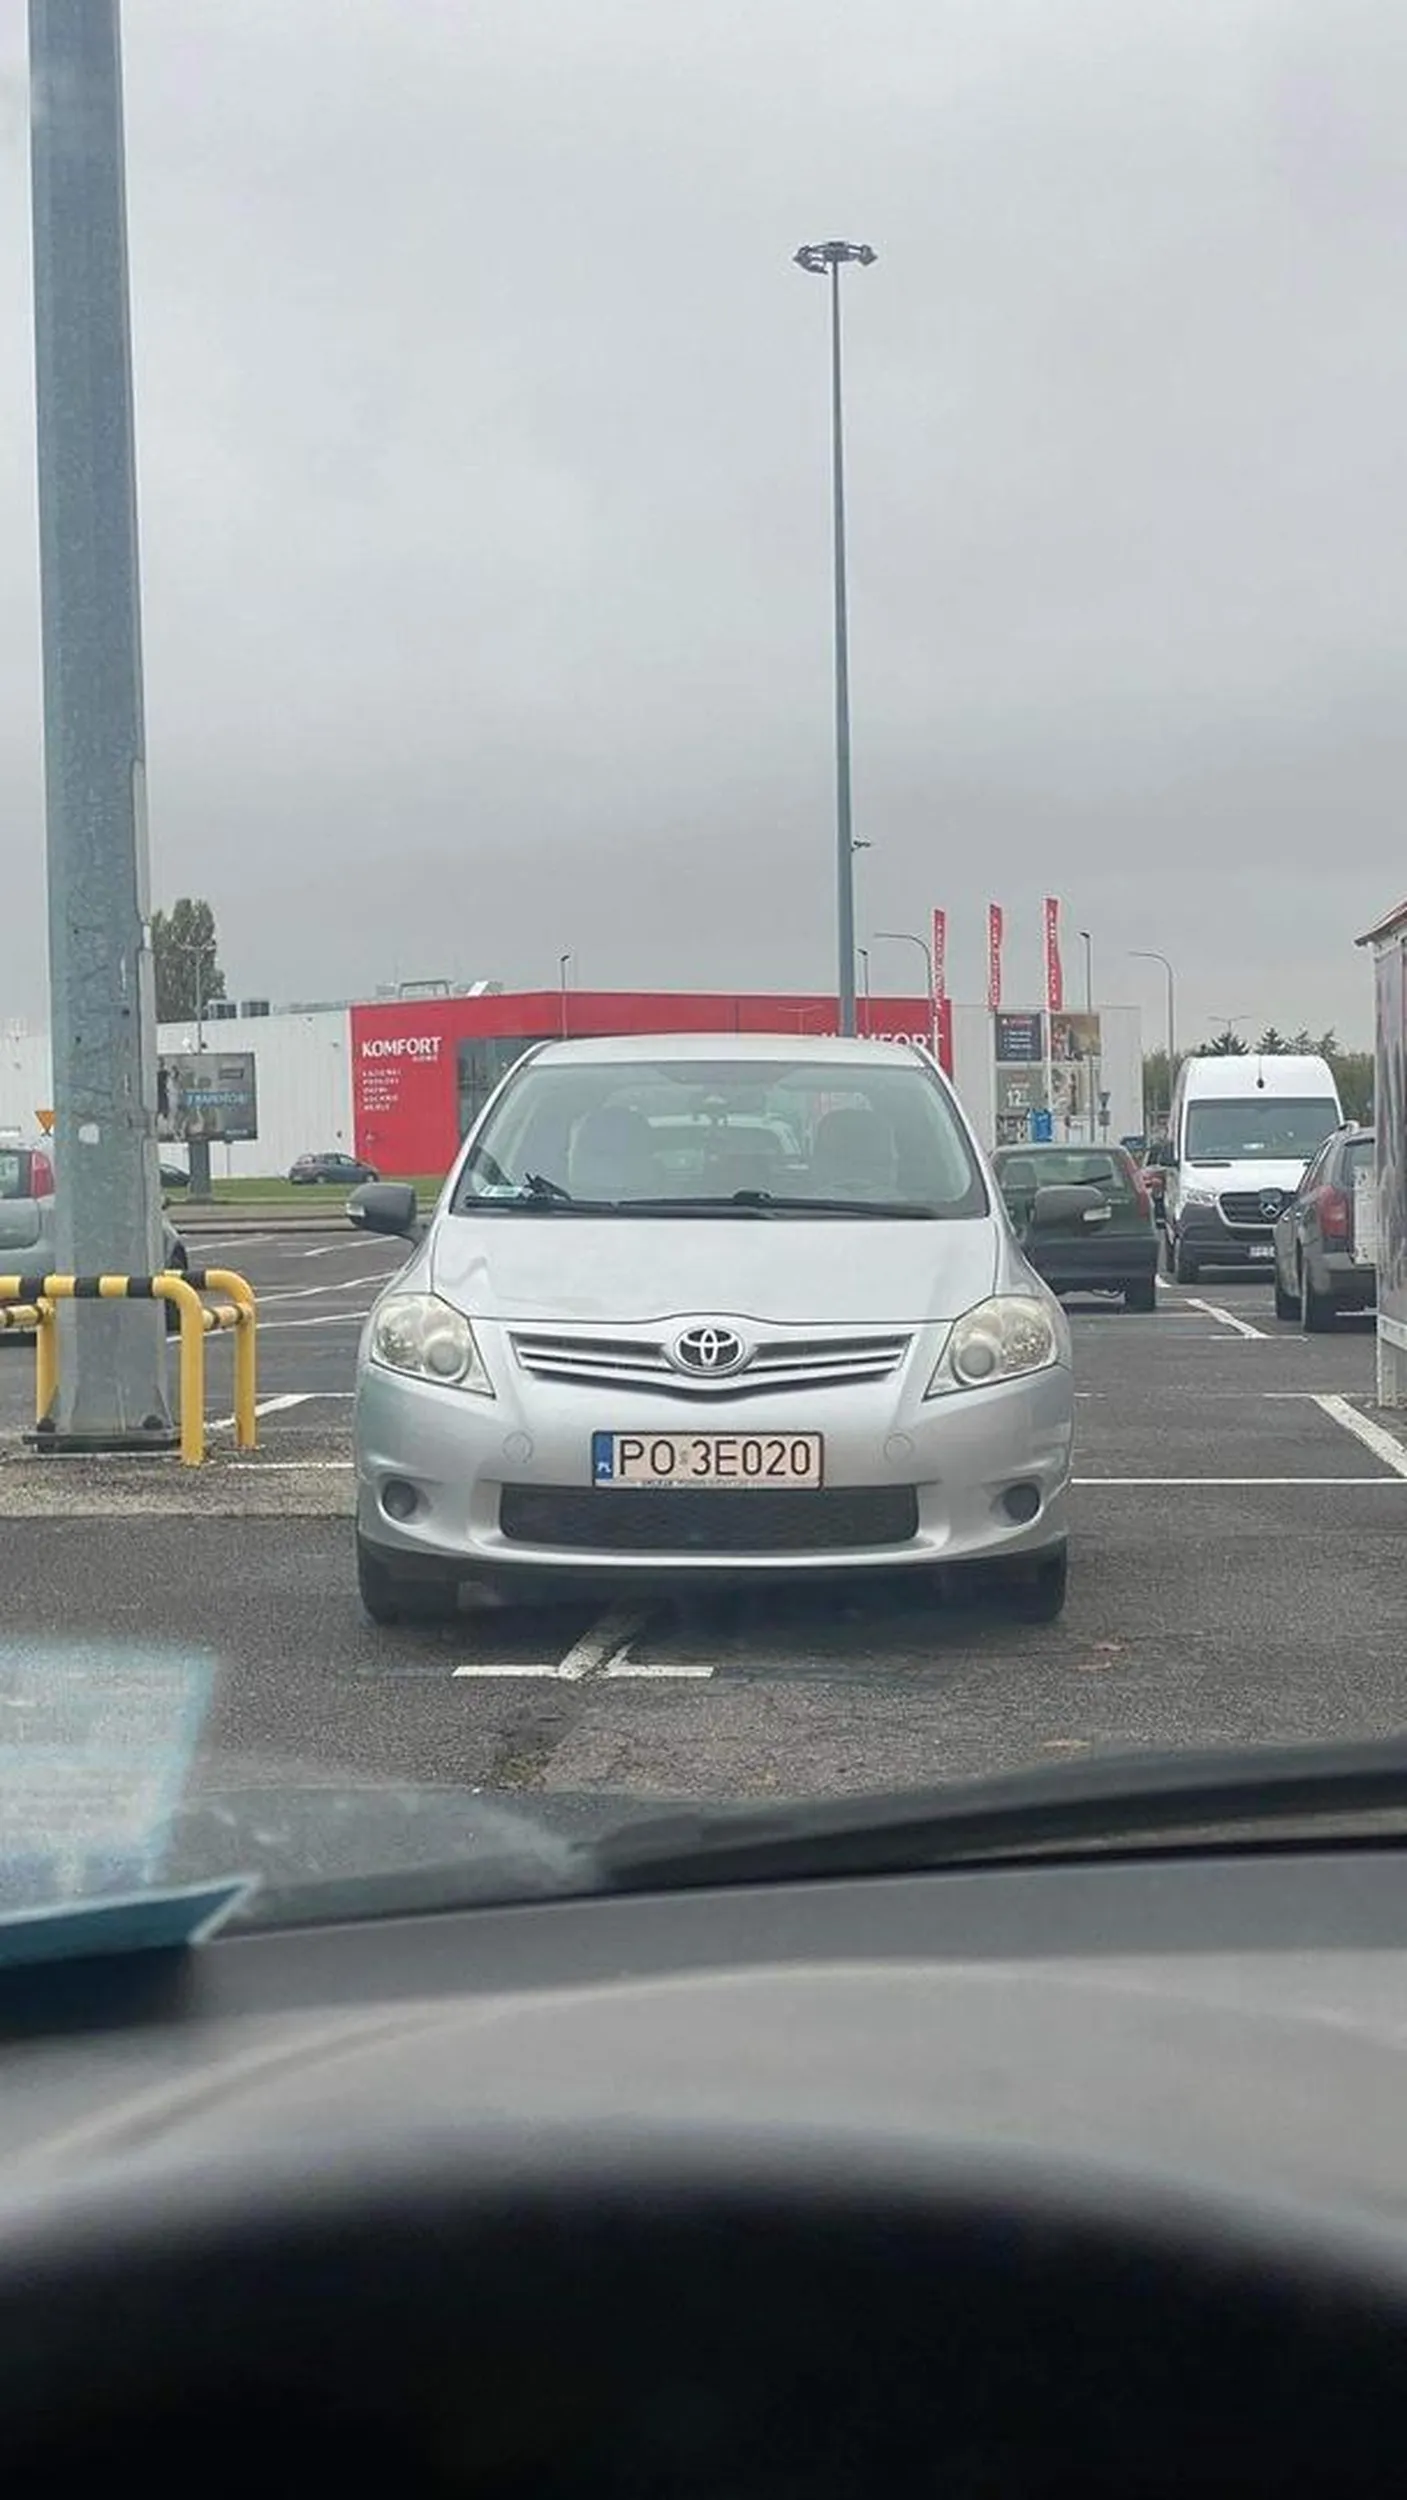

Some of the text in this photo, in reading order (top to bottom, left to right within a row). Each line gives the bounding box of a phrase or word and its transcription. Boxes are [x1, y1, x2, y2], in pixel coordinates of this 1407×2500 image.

[361, 1036, 442, 1058] KOMFORT
[619, 1439, 812, 1476] PO 3E020
